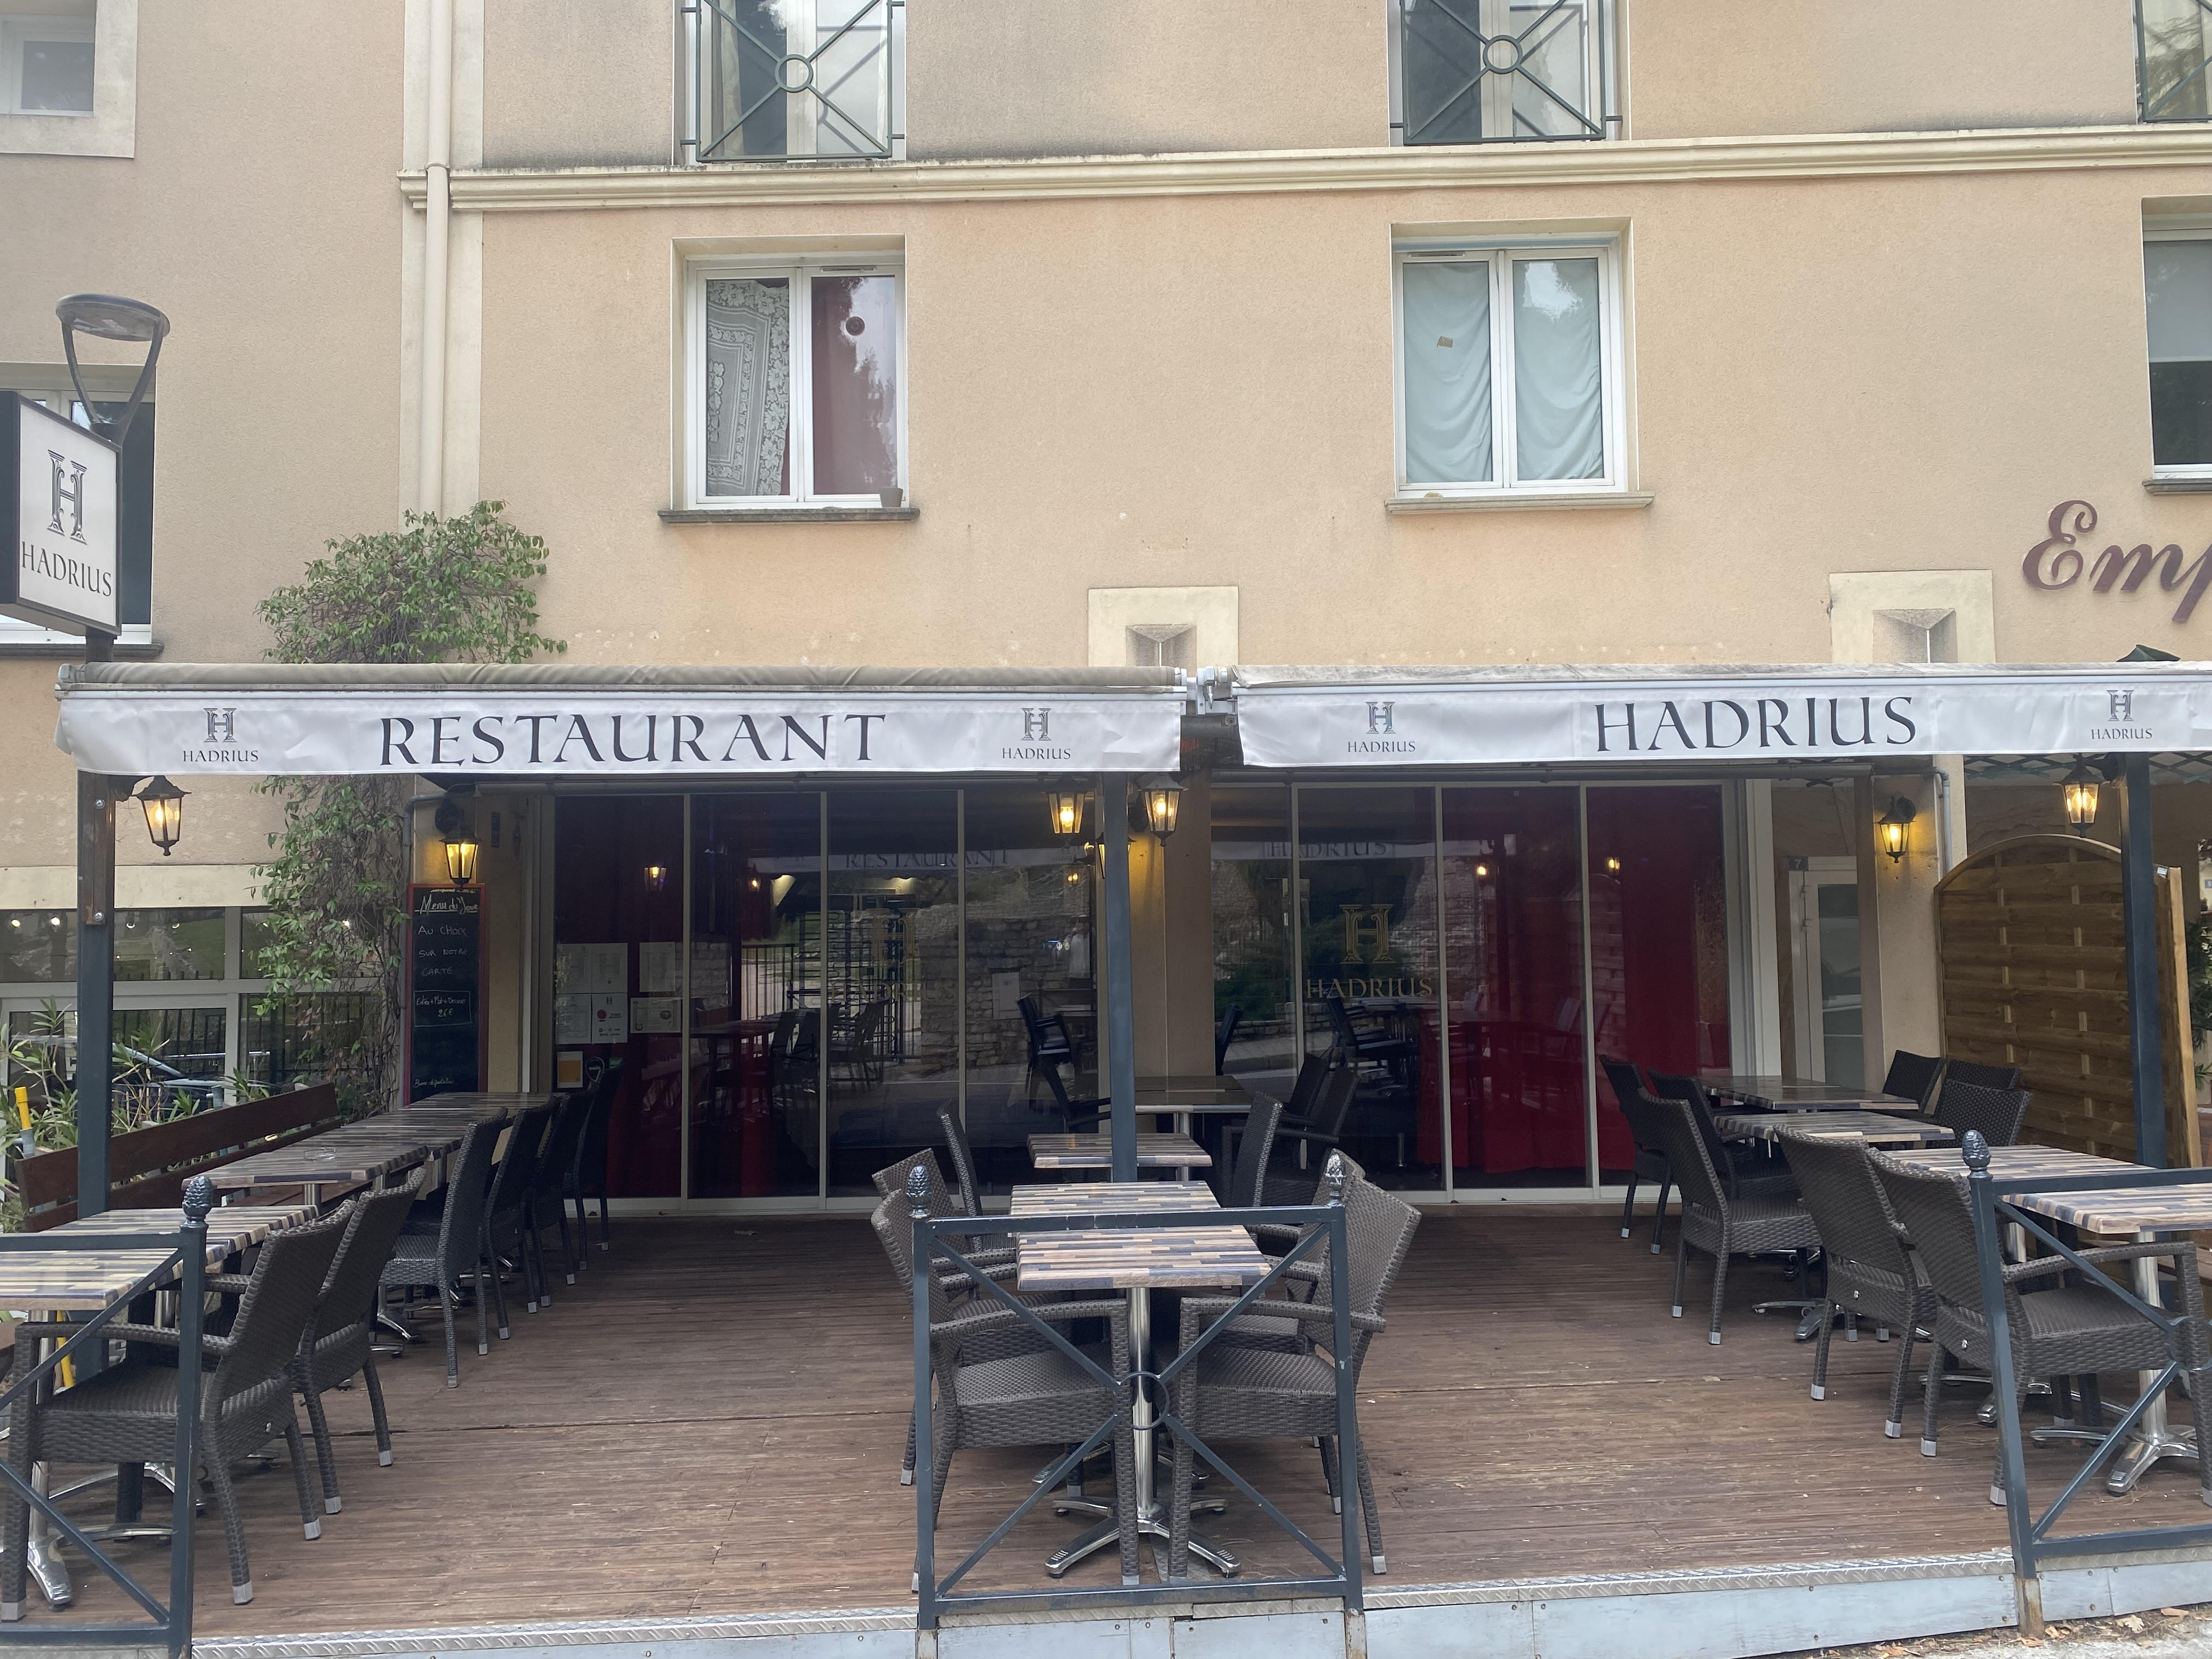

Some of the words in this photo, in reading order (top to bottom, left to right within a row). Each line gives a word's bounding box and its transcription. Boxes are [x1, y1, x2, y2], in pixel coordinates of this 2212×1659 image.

[21, 541, 112, 597] HADRIUS
[1593, 696, 1916, 752] HADRIUS
[379, 713, 886, 767] RESTAURANT
[2091, 727, 2153, 740] HADRIUS
[1002, 747, 1071, 760] HADRIUS
[1347, 741, 1416, 753] HADRIUS
[183, 749, 259, 763] HADRIUS
[1271, 842, 1387, 857] HDRIUS
[1795, 859, 1802, 868] 7
[419, 894, 448, 915] Menu
[448, 898, 458, 910] du
[419, 950, 437, 958] SUR
[422, 967, 453, 977] CARTE
[1306, 977, 1433, 999] HADRIUS
